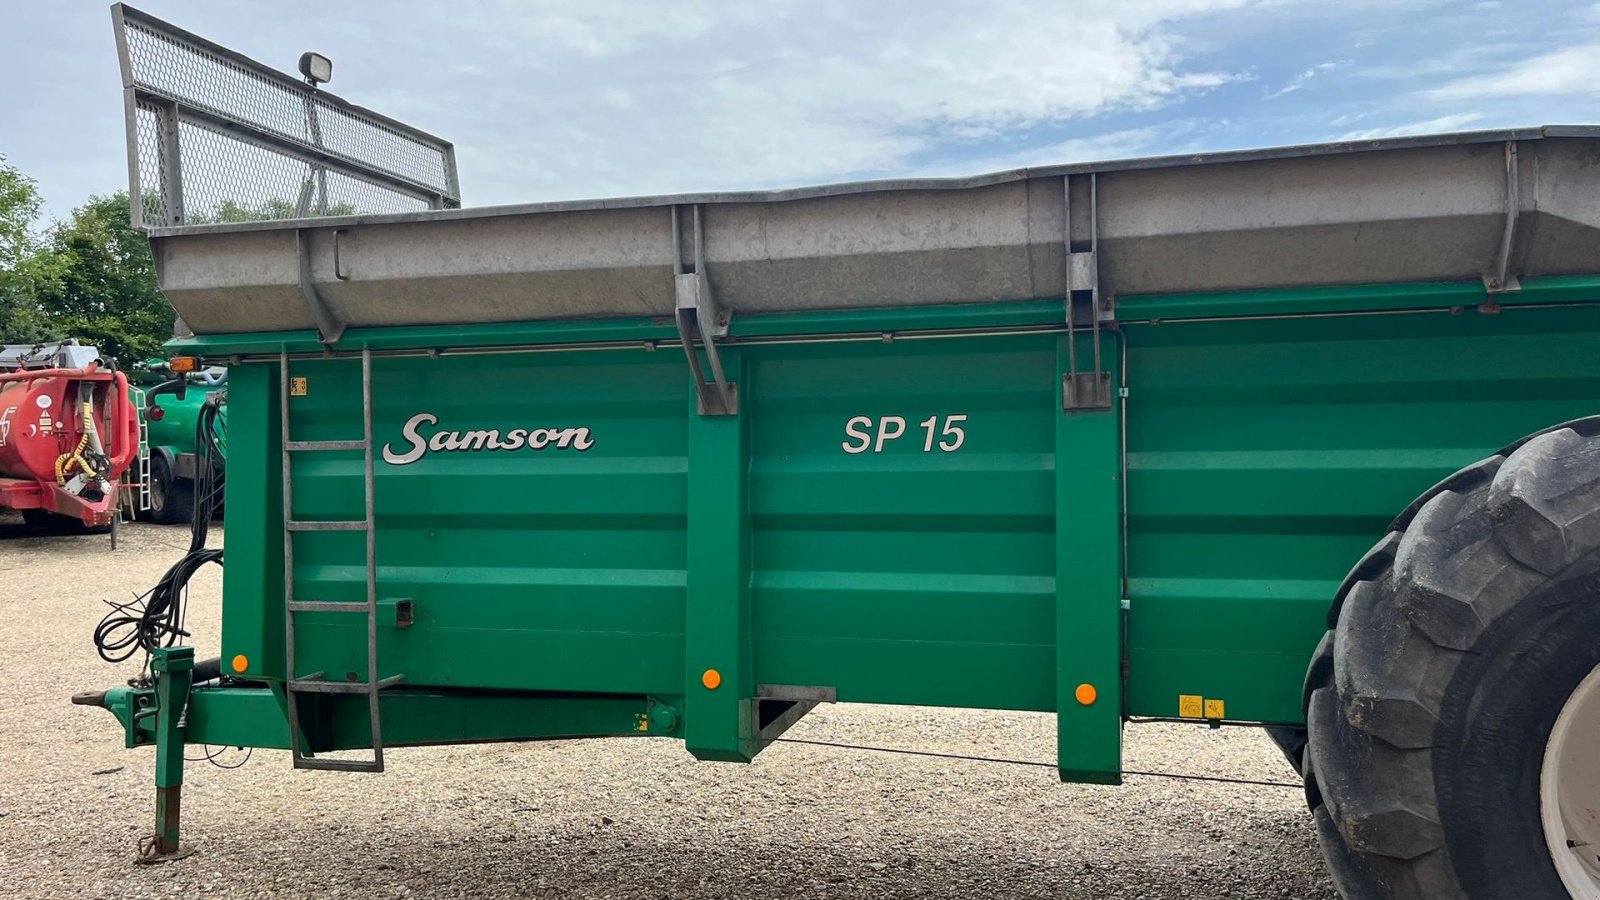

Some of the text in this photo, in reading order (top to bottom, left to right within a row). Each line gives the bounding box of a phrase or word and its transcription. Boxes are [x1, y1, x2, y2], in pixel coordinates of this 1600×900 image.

[382, 412, 594, 465] Samson
[841, 414, 967, 454] SP 15
